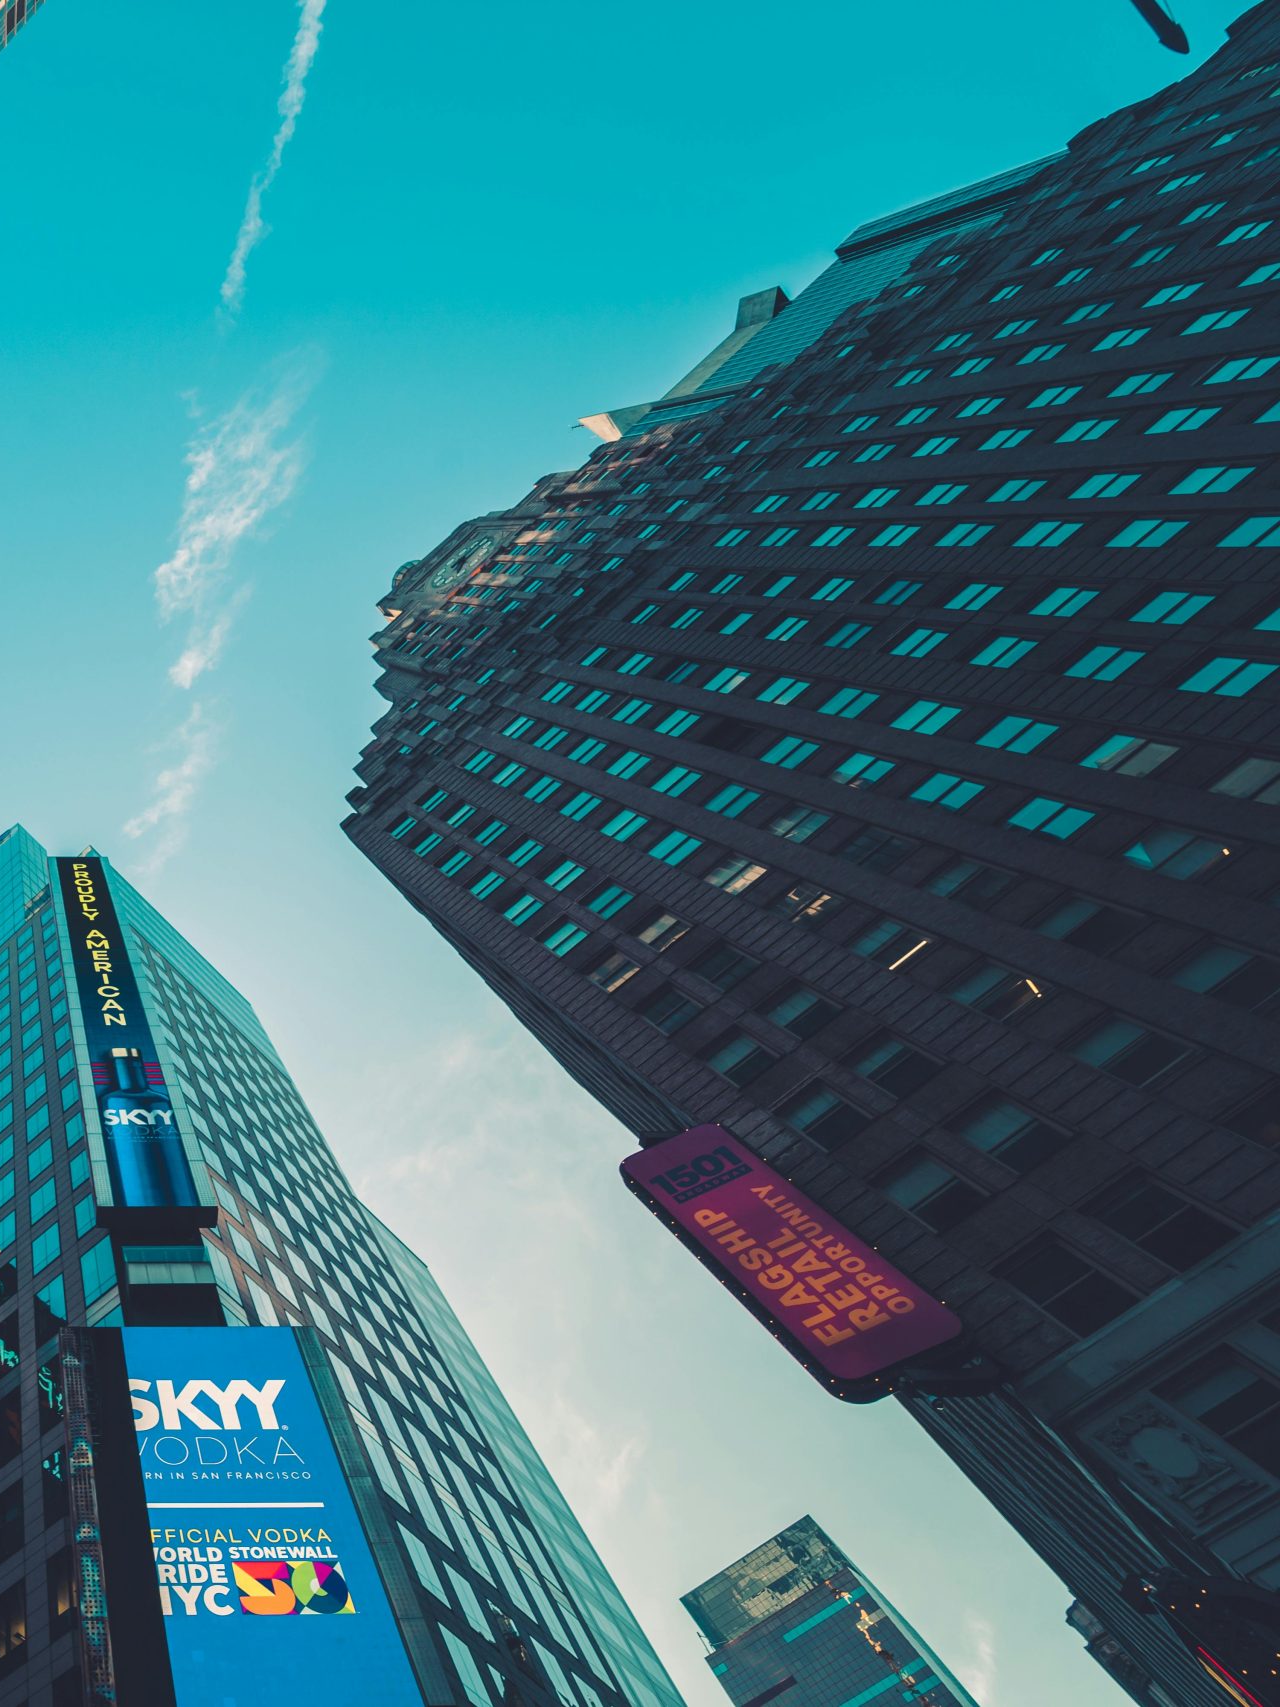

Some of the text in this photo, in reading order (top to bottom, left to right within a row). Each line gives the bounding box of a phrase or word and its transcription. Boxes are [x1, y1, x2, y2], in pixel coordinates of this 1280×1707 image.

[72, 863, 127, 1026] PROUDLY AMERICAN
[102, 1108, 174, 1126] SKYY
[104, 1126, 179, 1136] VODKA
[649, 1145, 744, 1196] 1501
[750, 1184, 915, 1315] OPPORTUNITY
[693, 1208, 856, 1347] FLAGSHIP
[766, 1228, 892, 1332] RETAIL
[170, 1471, 185, 1480] IN
[191, 1471, 220, 1480] SAN
[227, 1471, 312, 1480] FRANCISCO
[228, 1546, 339, 1560] STONEWALL
[247, 1528, 333, 1544] VODKA
